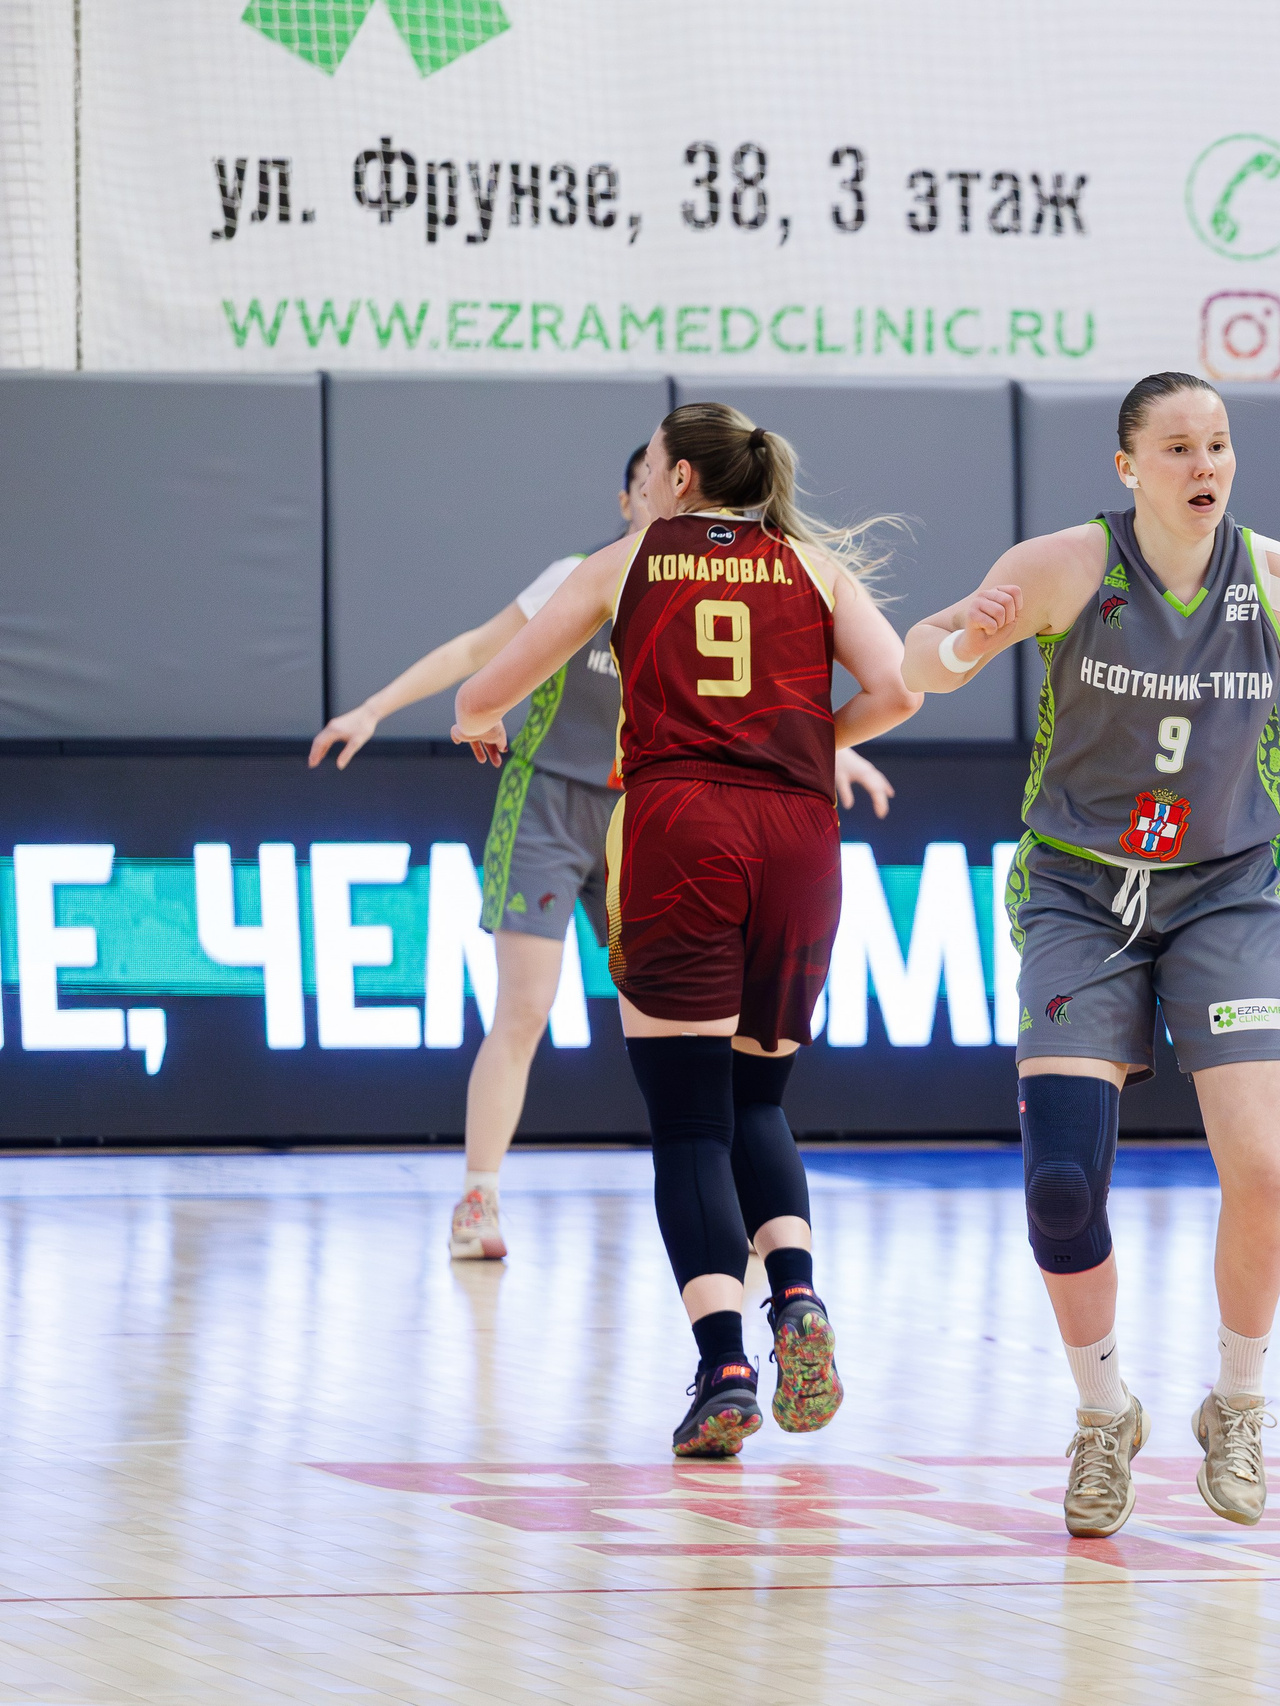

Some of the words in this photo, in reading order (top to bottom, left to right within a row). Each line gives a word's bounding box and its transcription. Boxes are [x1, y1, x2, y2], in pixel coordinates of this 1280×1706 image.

[211, 156, 316, 241] ул.
[352, 137, 643, 246] Фрунзе,
[682, 141, 792, 247] 38,
[830, 145, 867, 233] 3
[906, 169, 1089, 236] этаж
[222, 297, 1096, 359] WWW.EZRAMEDCLINIC.RU
[647, 553, 770, 584] КОМАРОВА
[772, 558, 793, 586] А.
[1103, 575, 1131, 593] PEAK
[1225, 603, 1260, 622] BET
[694, 599, 752, 698] 9
[1080, 656, 1274, 701] НЕФТЯНИК-ТИТАН
[1154, 716, 1192, 774] 9
[1238, 1014, 1271, 1023] CLINIC
